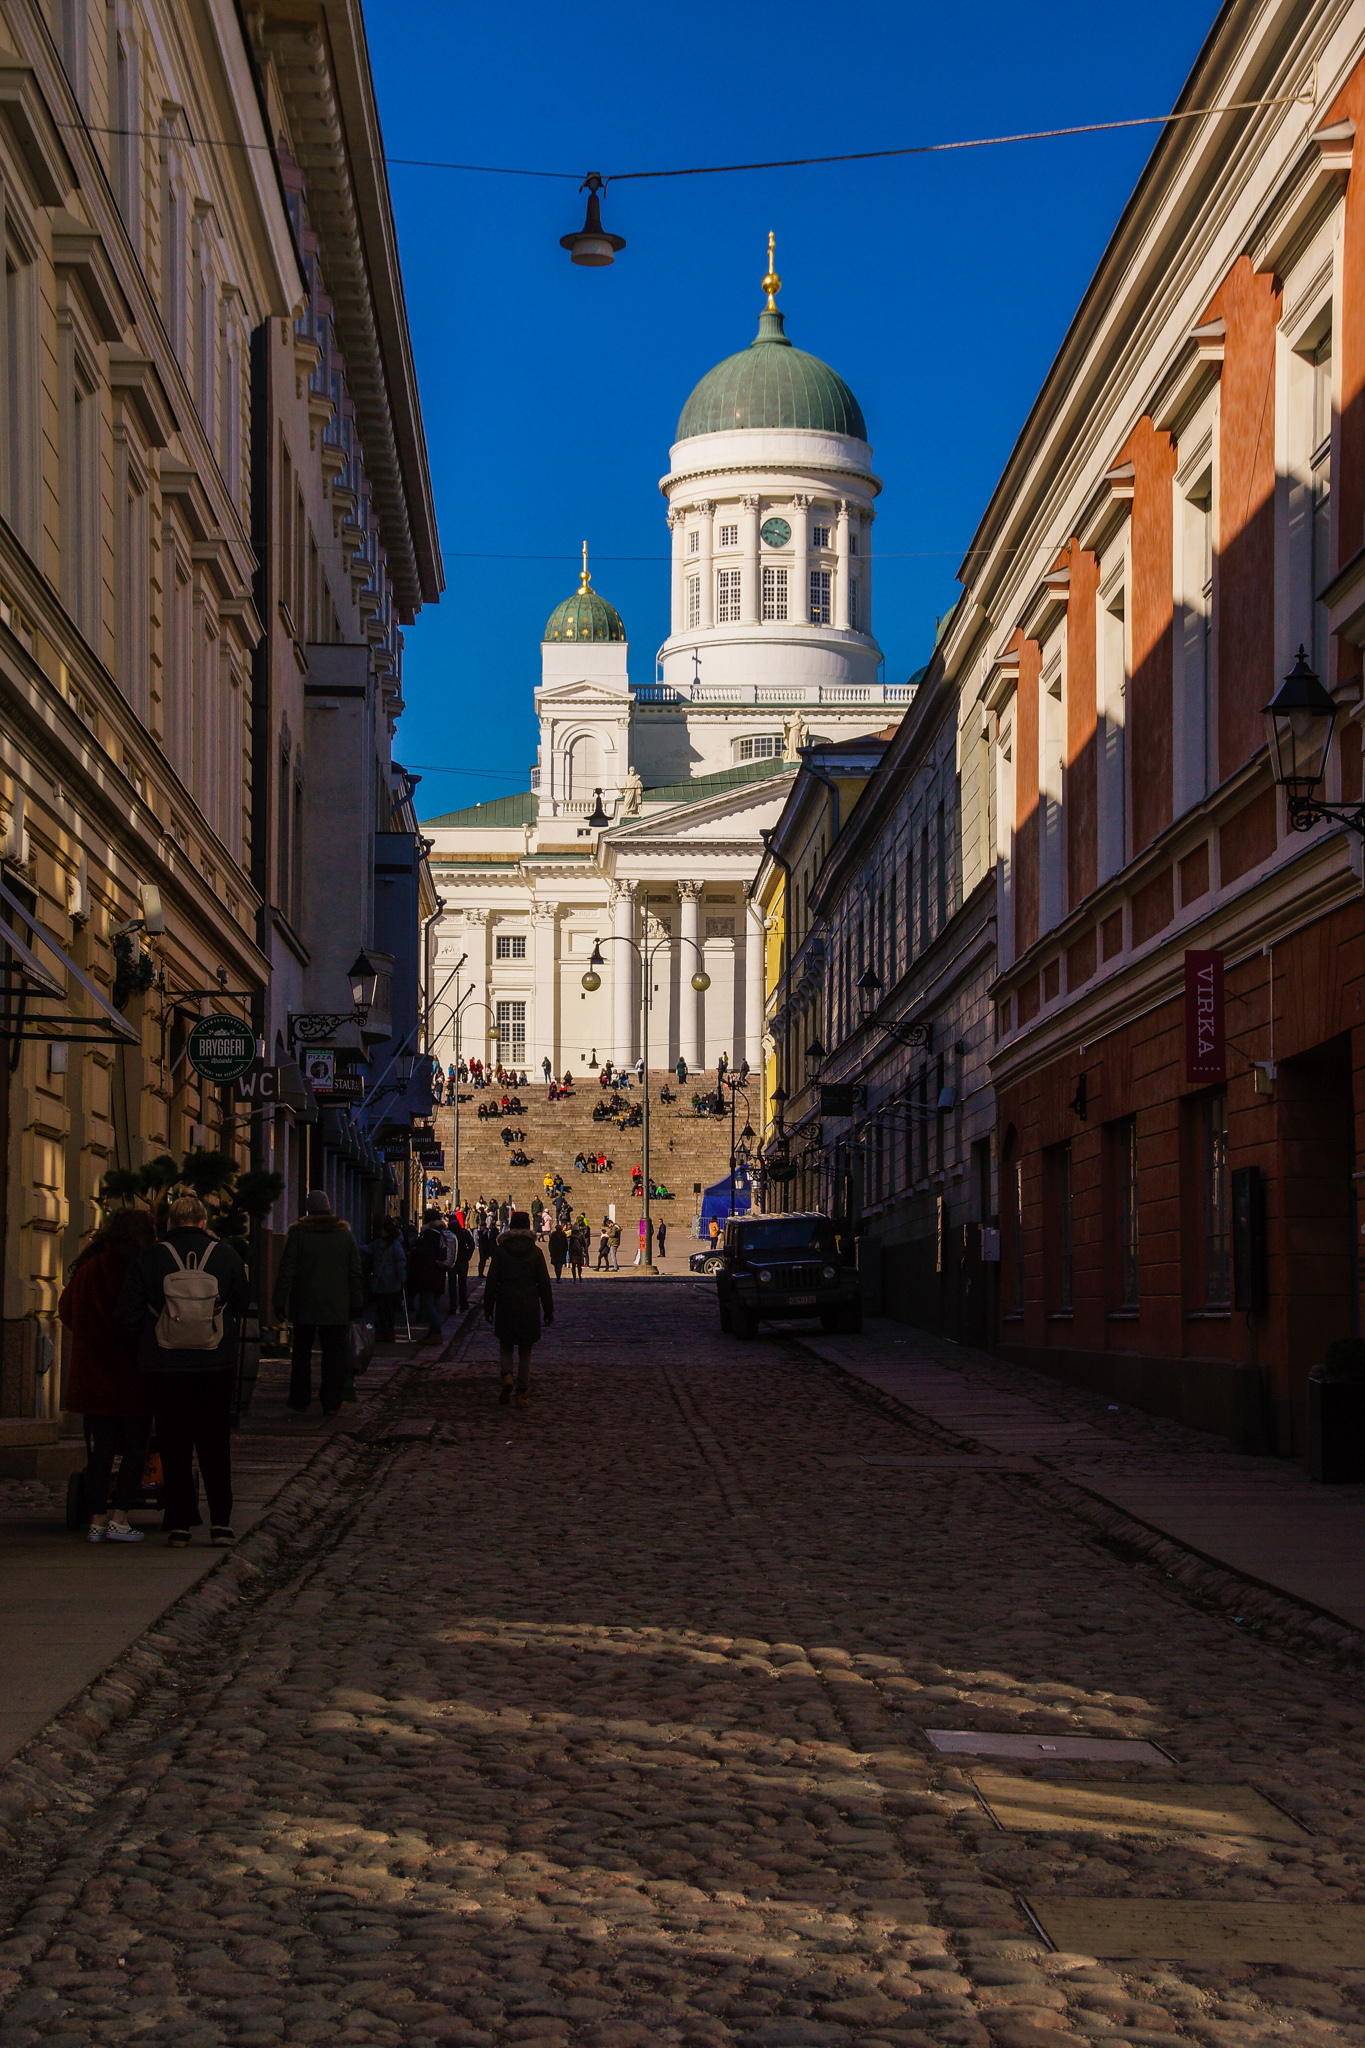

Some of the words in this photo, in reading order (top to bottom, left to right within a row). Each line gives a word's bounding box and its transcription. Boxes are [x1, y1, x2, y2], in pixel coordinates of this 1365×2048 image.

[1197, 963, 1215, 1058] VIRKA
[199, 1038, 245, 1056] BRYGGERI
[238, 1072, 273, 1096] WC
